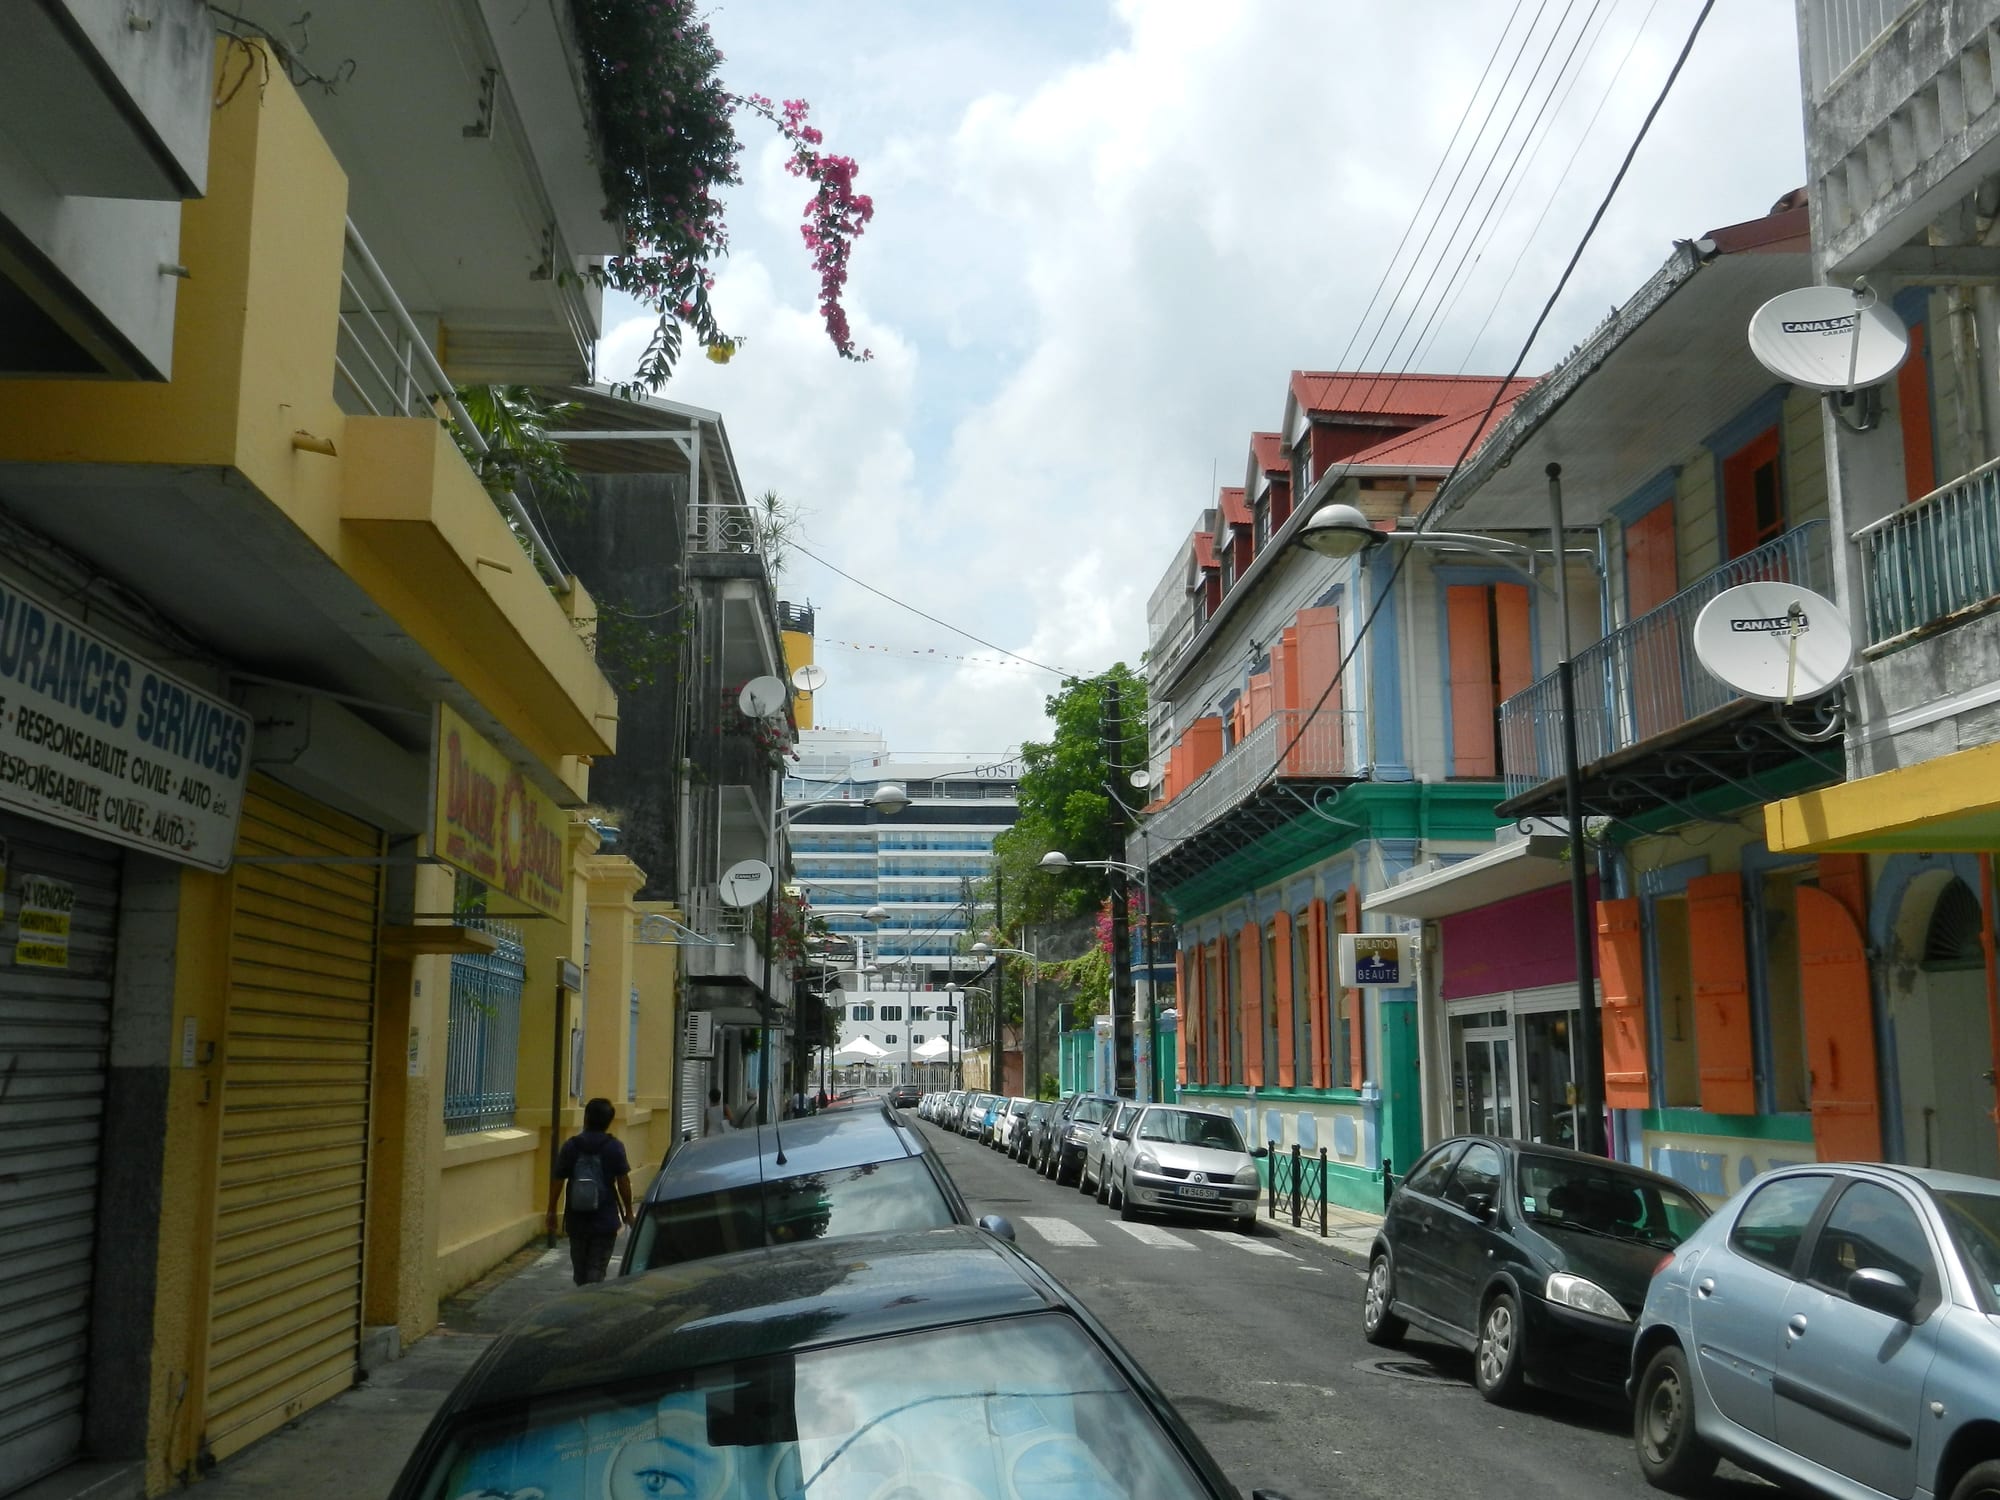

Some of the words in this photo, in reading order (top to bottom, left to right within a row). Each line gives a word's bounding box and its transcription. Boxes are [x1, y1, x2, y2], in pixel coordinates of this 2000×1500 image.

[1732, 616, 1807, 630] CANALST
[0, 587, 131, 728] URANCES
[137, 673, 246, 780] SERVICES
[131, 757, 171, 796] CIVILE
[178, 776, 211, 810] AUTO
[975, 764, 1026, 778] COSTA
[104, 796, 144, 834] CIVILE
[153, 810, 184, 846] AUTO
